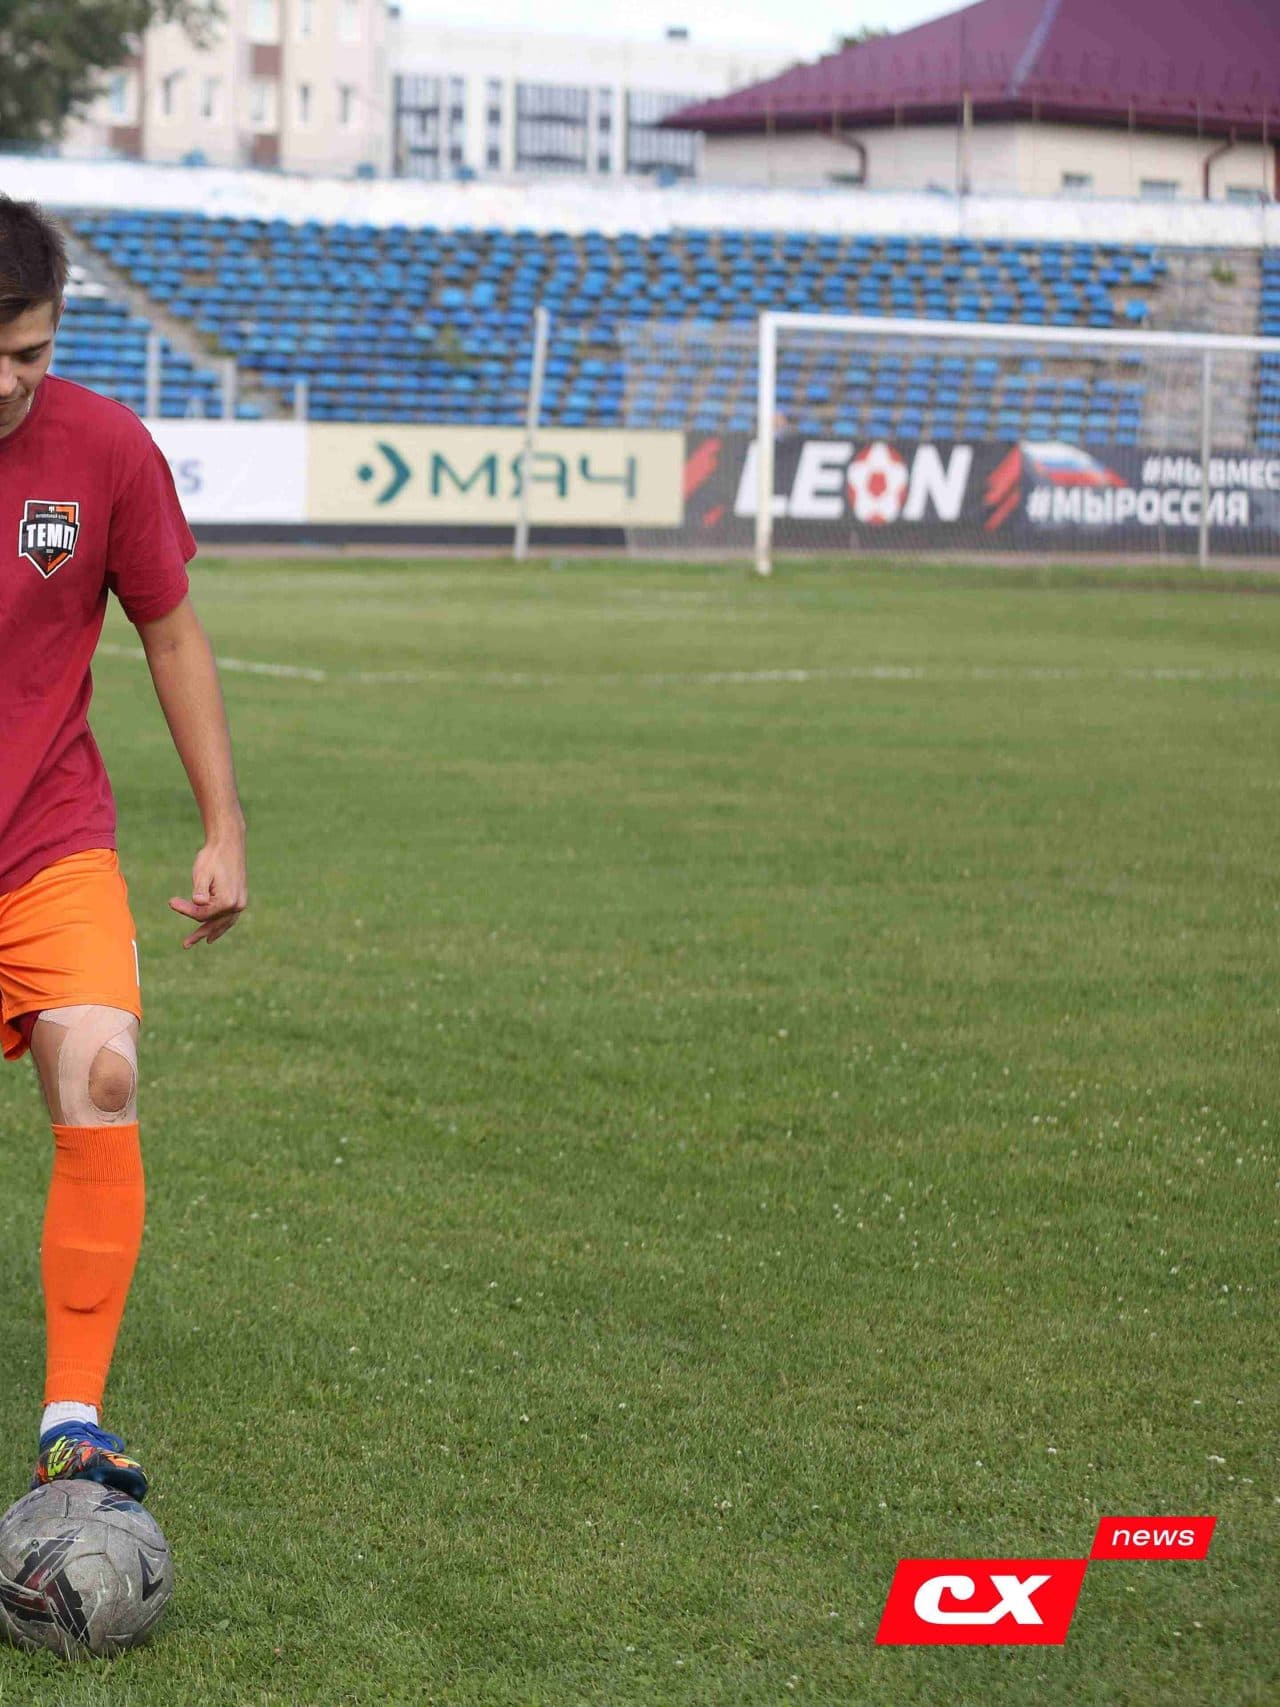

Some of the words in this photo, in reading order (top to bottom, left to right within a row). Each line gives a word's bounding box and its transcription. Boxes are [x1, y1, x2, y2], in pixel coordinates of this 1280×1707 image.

[430, 452, 635, 499] МЯЧ
[733, 440, 973, 522] LEON
[1026, 486, 1250, 526] #МЫРОССИЯ
[25, 523, 75, 551] ТЕМП
